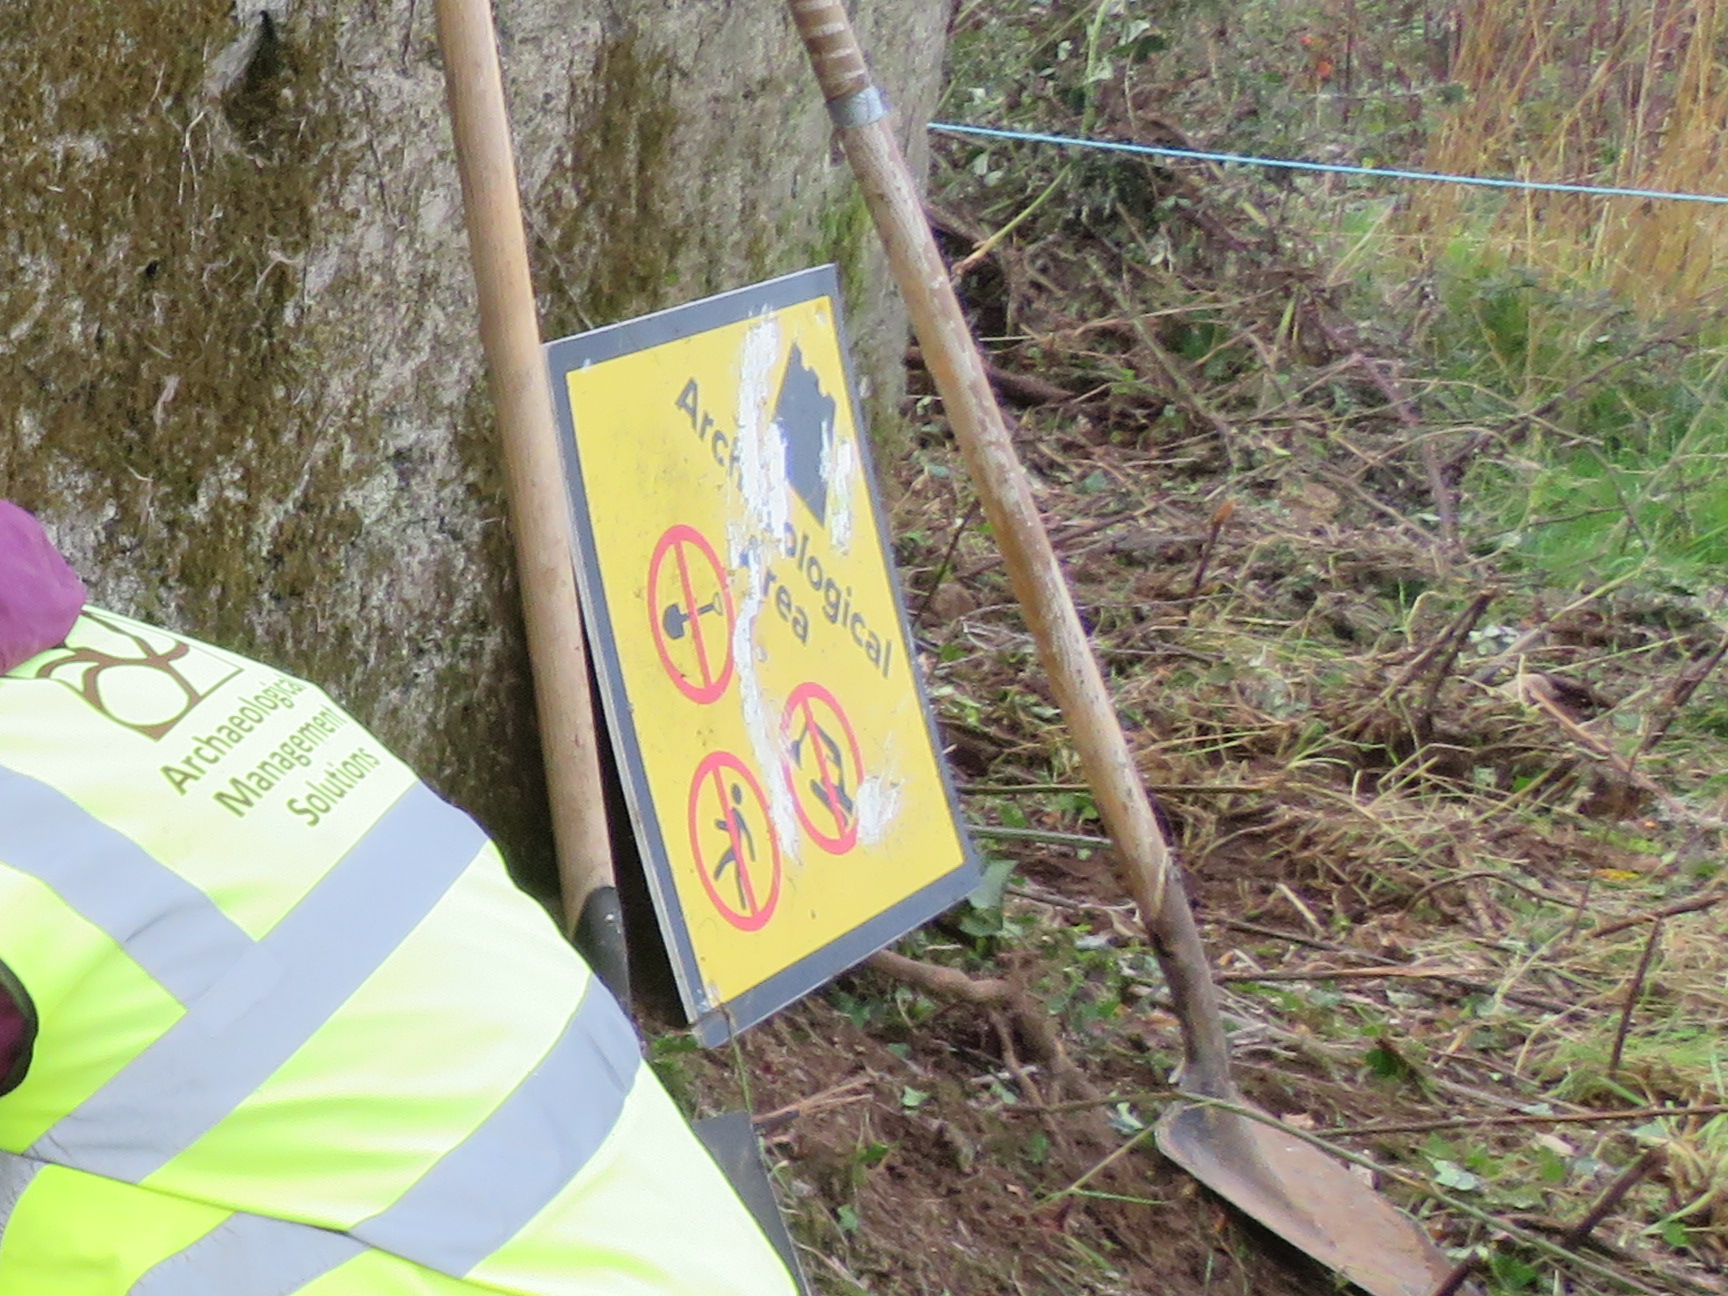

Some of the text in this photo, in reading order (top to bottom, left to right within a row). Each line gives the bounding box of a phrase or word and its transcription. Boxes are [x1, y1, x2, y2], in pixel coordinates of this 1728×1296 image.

[674, 377, 893, 679] Archological
[160, 673, 307, 796] Archaeological
[213, 704, 347, 818] Management
[286, 748, 381, 826] Solutions
